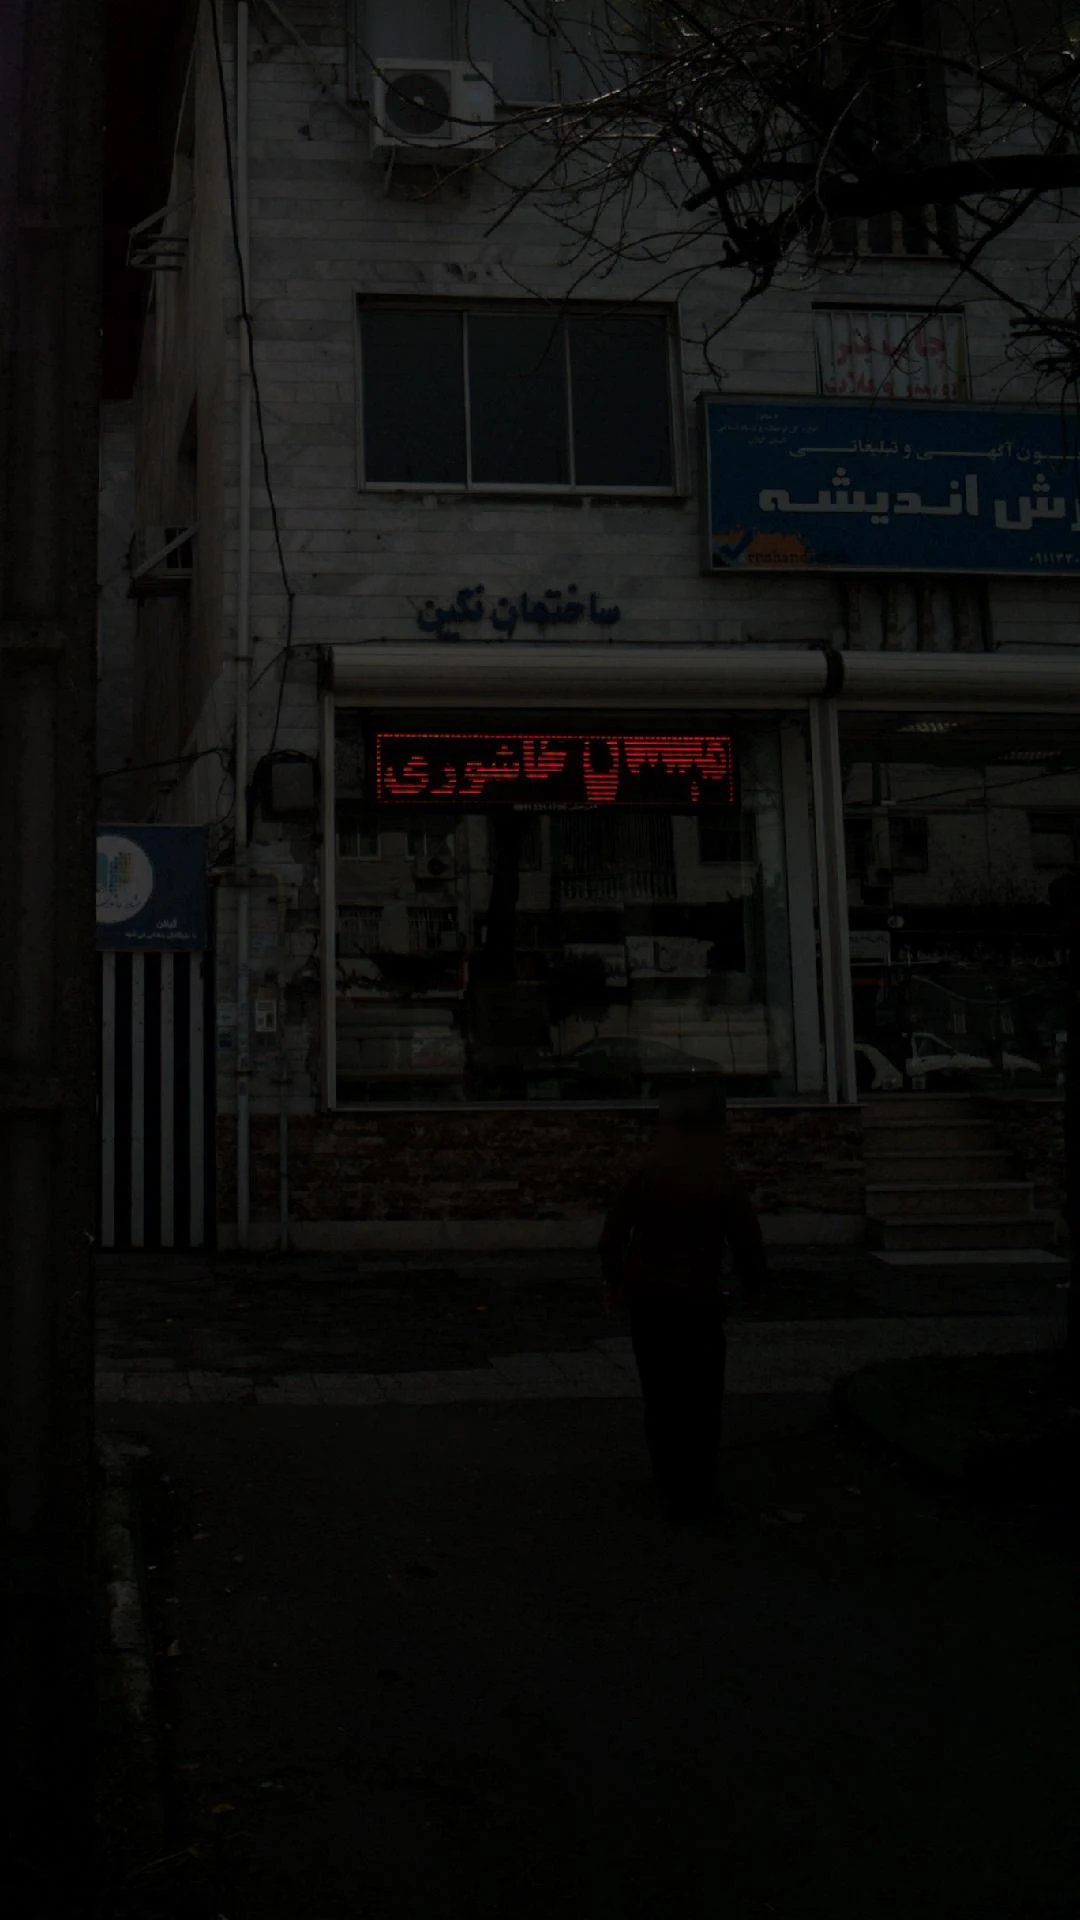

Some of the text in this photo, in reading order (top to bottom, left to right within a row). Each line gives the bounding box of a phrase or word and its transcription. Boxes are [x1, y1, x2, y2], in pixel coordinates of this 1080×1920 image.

[758, 465, 981, 525] اندیشه
[417, 583, 622, 641] ساختمان نگین
